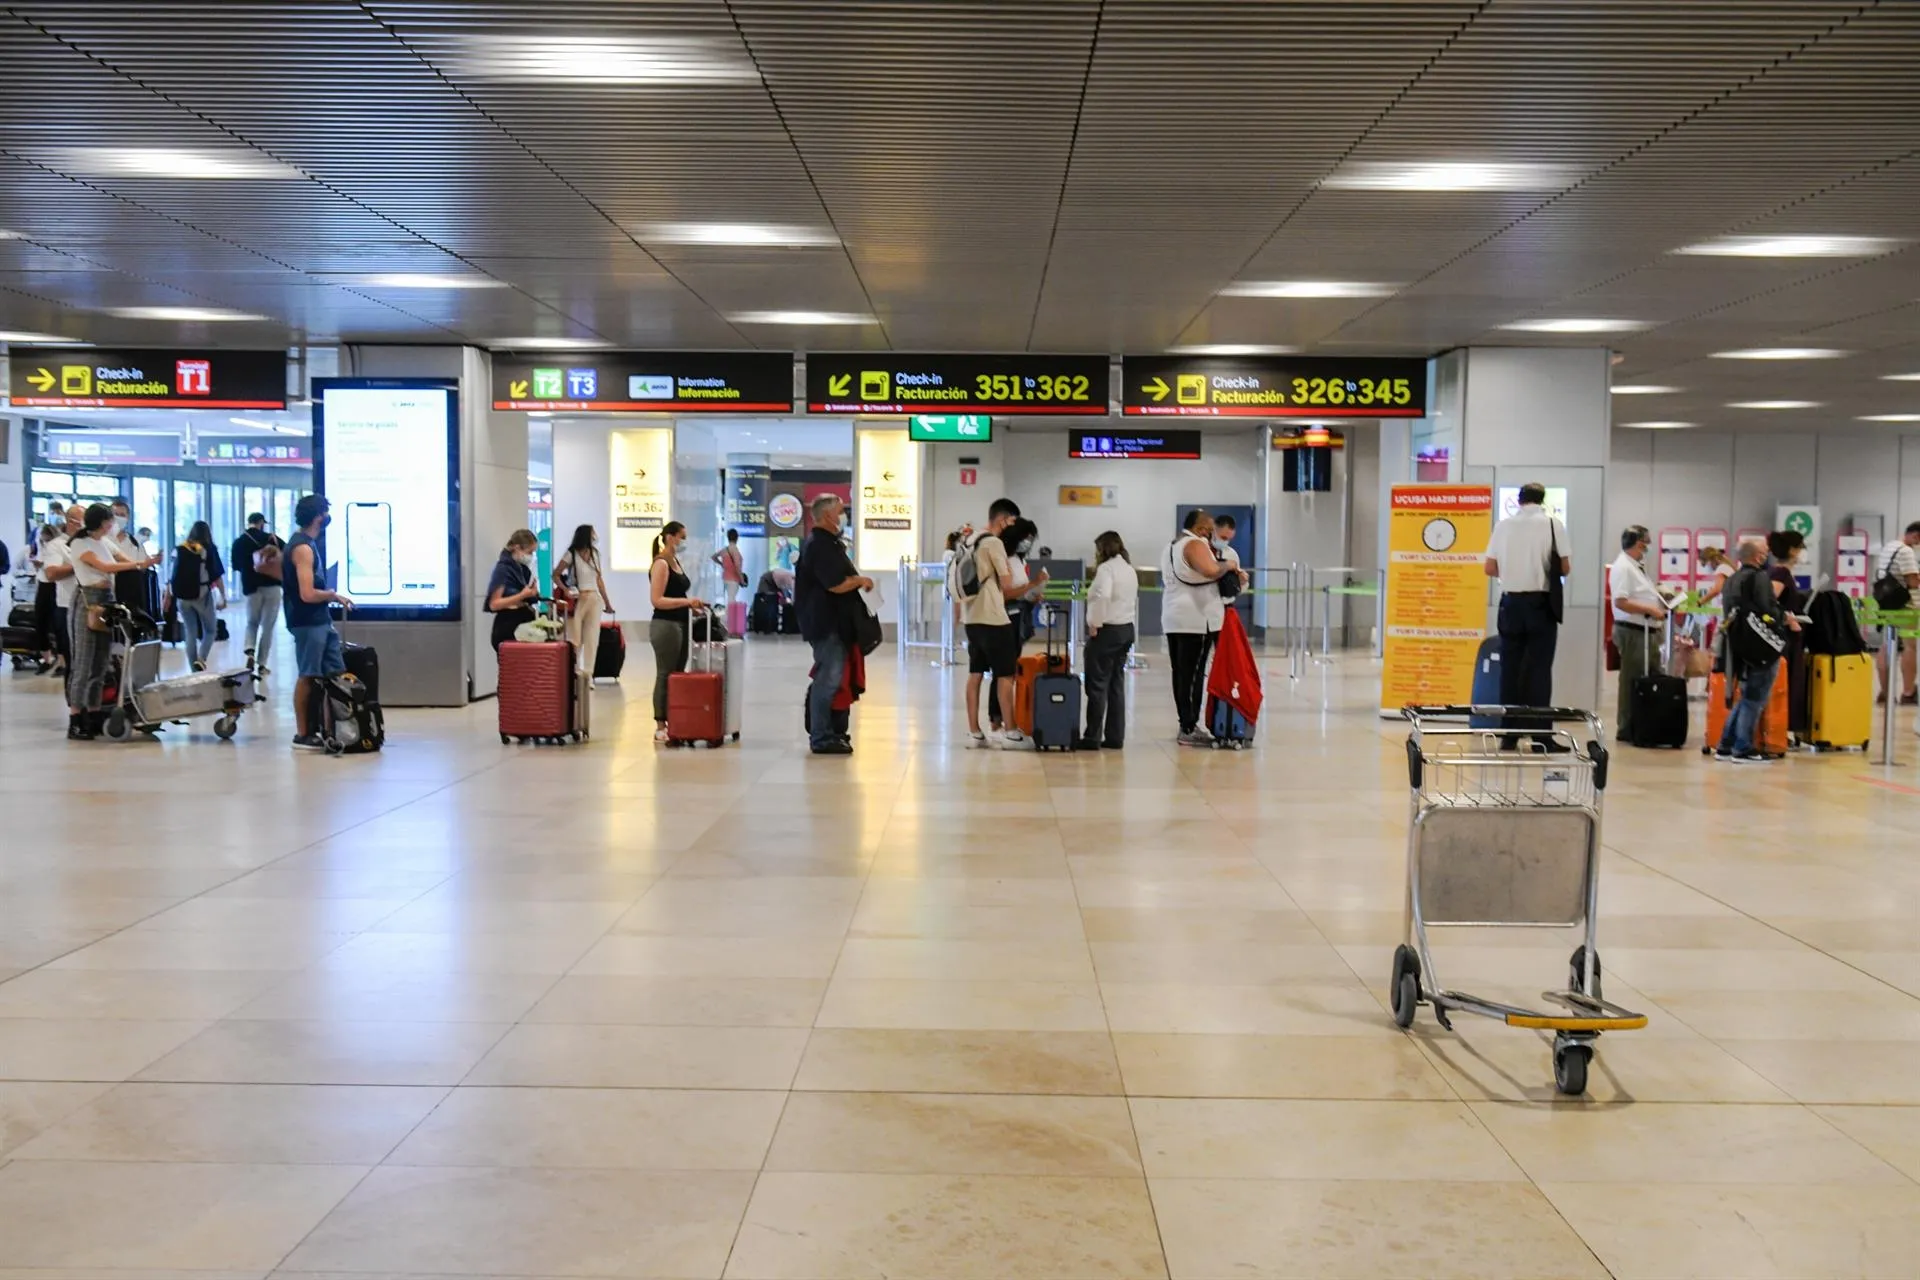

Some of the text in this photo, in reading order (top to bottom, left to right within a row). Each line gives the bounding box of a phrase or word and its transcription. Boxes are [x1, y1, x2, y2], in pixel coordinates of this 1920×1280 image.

[96, 367, 144, 380] Check-in
[177, 369, 209, 391] T1
[895, 372, 943, 385] Check-in
[96, 381, 168, 394] Facturación
[535, 376, 561, 395] T2
[569, 376, 595, 395] T3
[677, 376, 725, 387] Information
[975, 374, 1089, 400] 351 to 362
[1211, 376, 1259, 388] Check-in
[677, 387, 740, 398] Información
[895, 386, 968, 400] Facturación
[1026, 390, 1034, 400] a
[1211, 390, 1285, 404] Facturación
[1291, 378, 1410, 404] 326 to 345
[1428, 495, 1457, 504] HAZIR
